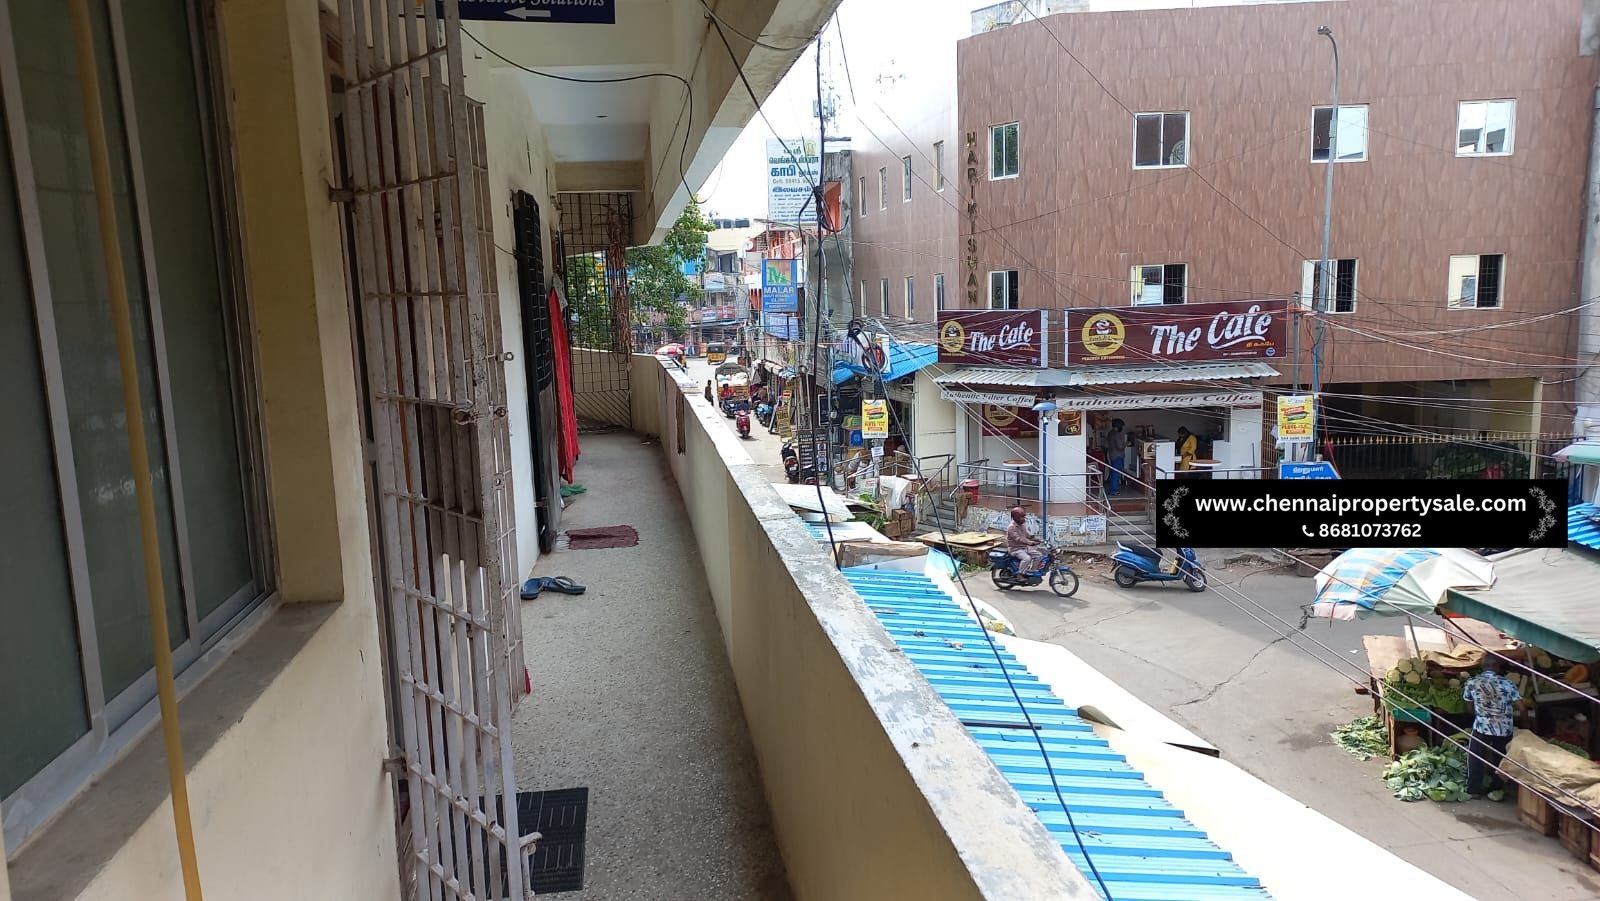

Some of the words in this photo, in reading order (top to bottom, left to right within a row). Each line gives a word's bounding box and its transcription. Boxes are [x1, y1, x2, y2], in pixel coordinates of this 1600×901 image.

[763, 286, 795, 294] MALAR
[971, 331, 996, 352] The
[999, 321, 1033, 347] Cafe
[1150, 324, 1202, 355] The
[1207, 304, 1272, 345] Cafe
[945, 391, 980, 400] Authentic
[1006, 394, 1034, 405] Coffee
[1063, 396, 1145, 407] Authentic
[1151, 395, 1198, 405] Filter
[1203, 393, 1260, 402] Coffee
